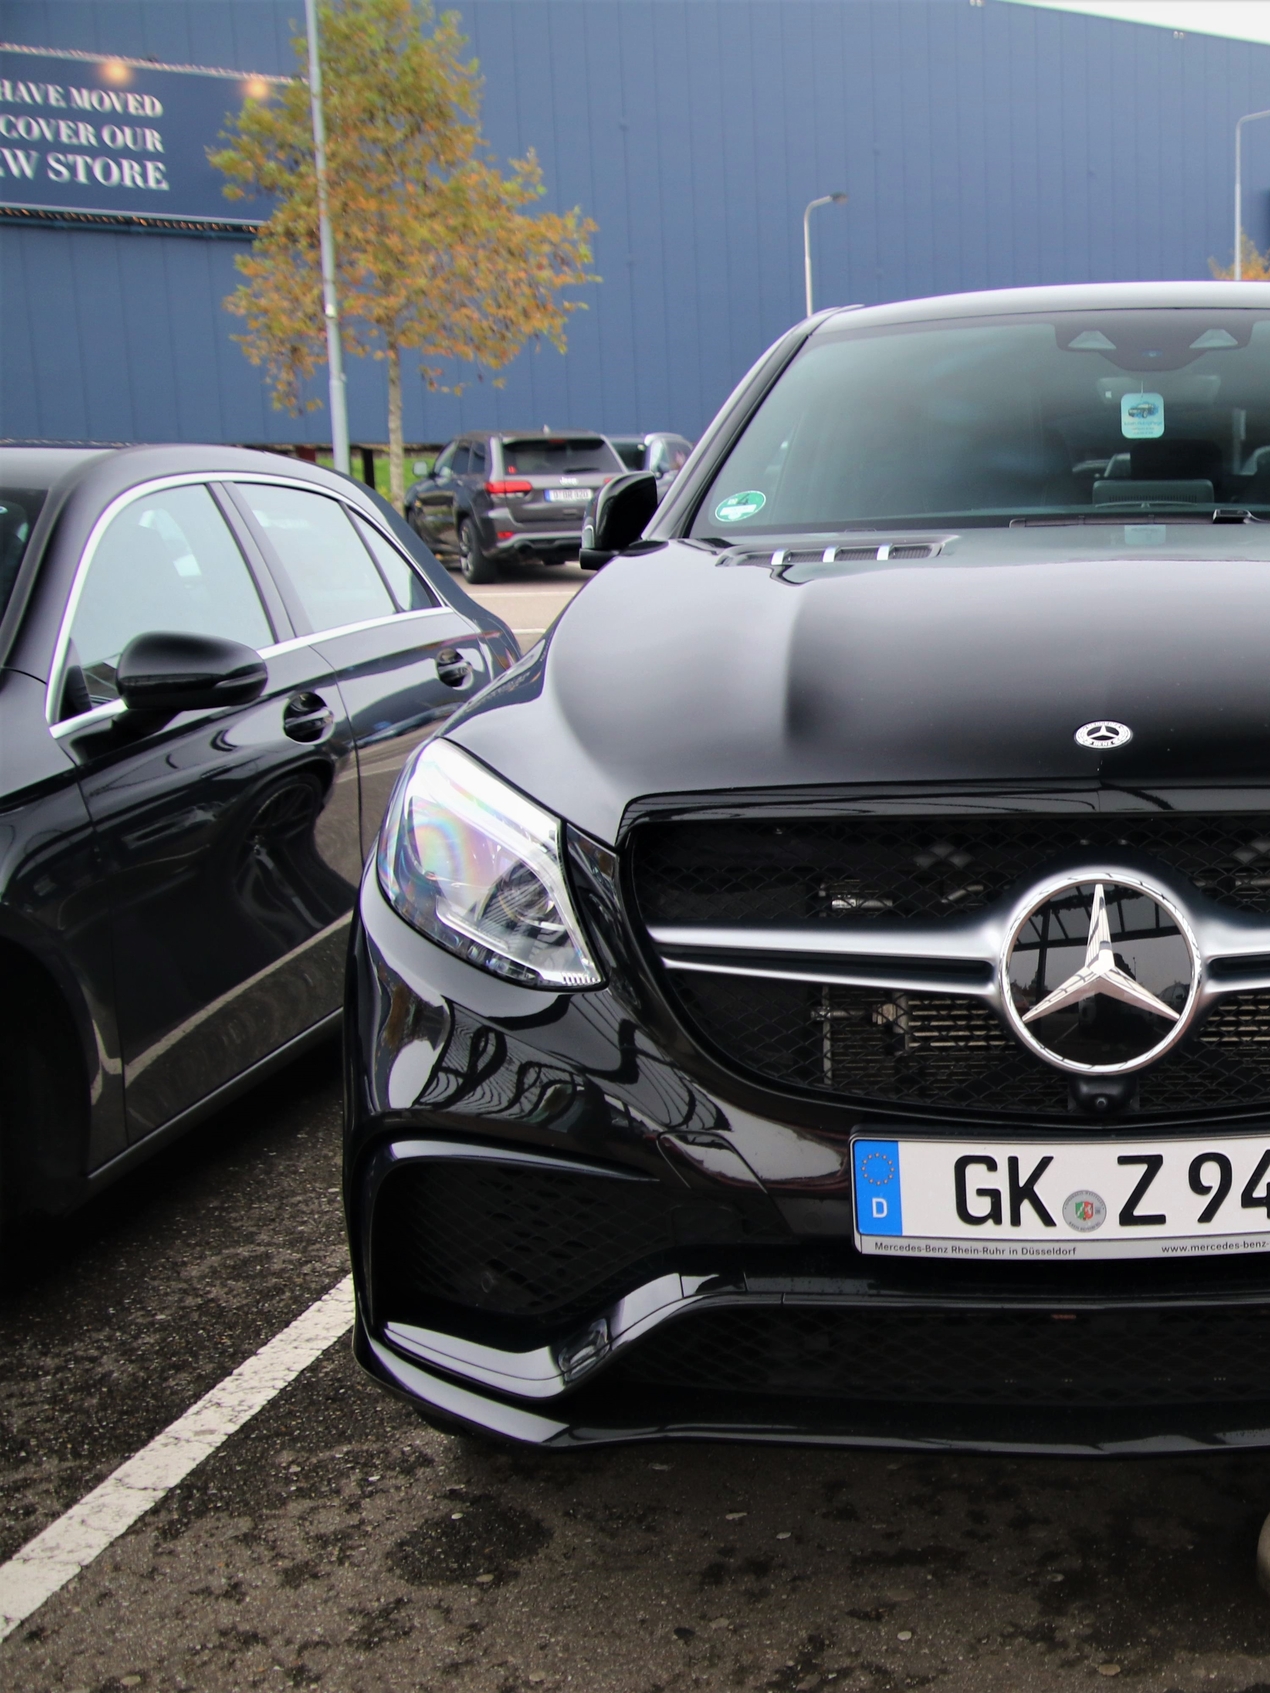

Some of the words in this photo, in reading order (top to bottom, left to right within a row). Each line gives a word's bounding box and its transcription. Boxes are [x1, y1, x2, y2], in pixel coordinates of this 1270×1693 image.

[0, 78, 67, 108] HAVE
[68, 86, 163, 118] MOVED
[101, 124, 165, 153] OUR
[46, 151, 170, 191] STORE
[872, 1197, 888, 1218] D
[953, 1154, 1058, 1227] GK
[1117, 1154, 1167, 1226] Z
[874, 1241, 948, 1254] Mercedes-Benz
[951, 1245, 1006, 1256] Rhein-Ruhr
[1008, 1246, 1018, 1256] in
[1021, 1246, 1077, 1256] Düsseldorf
